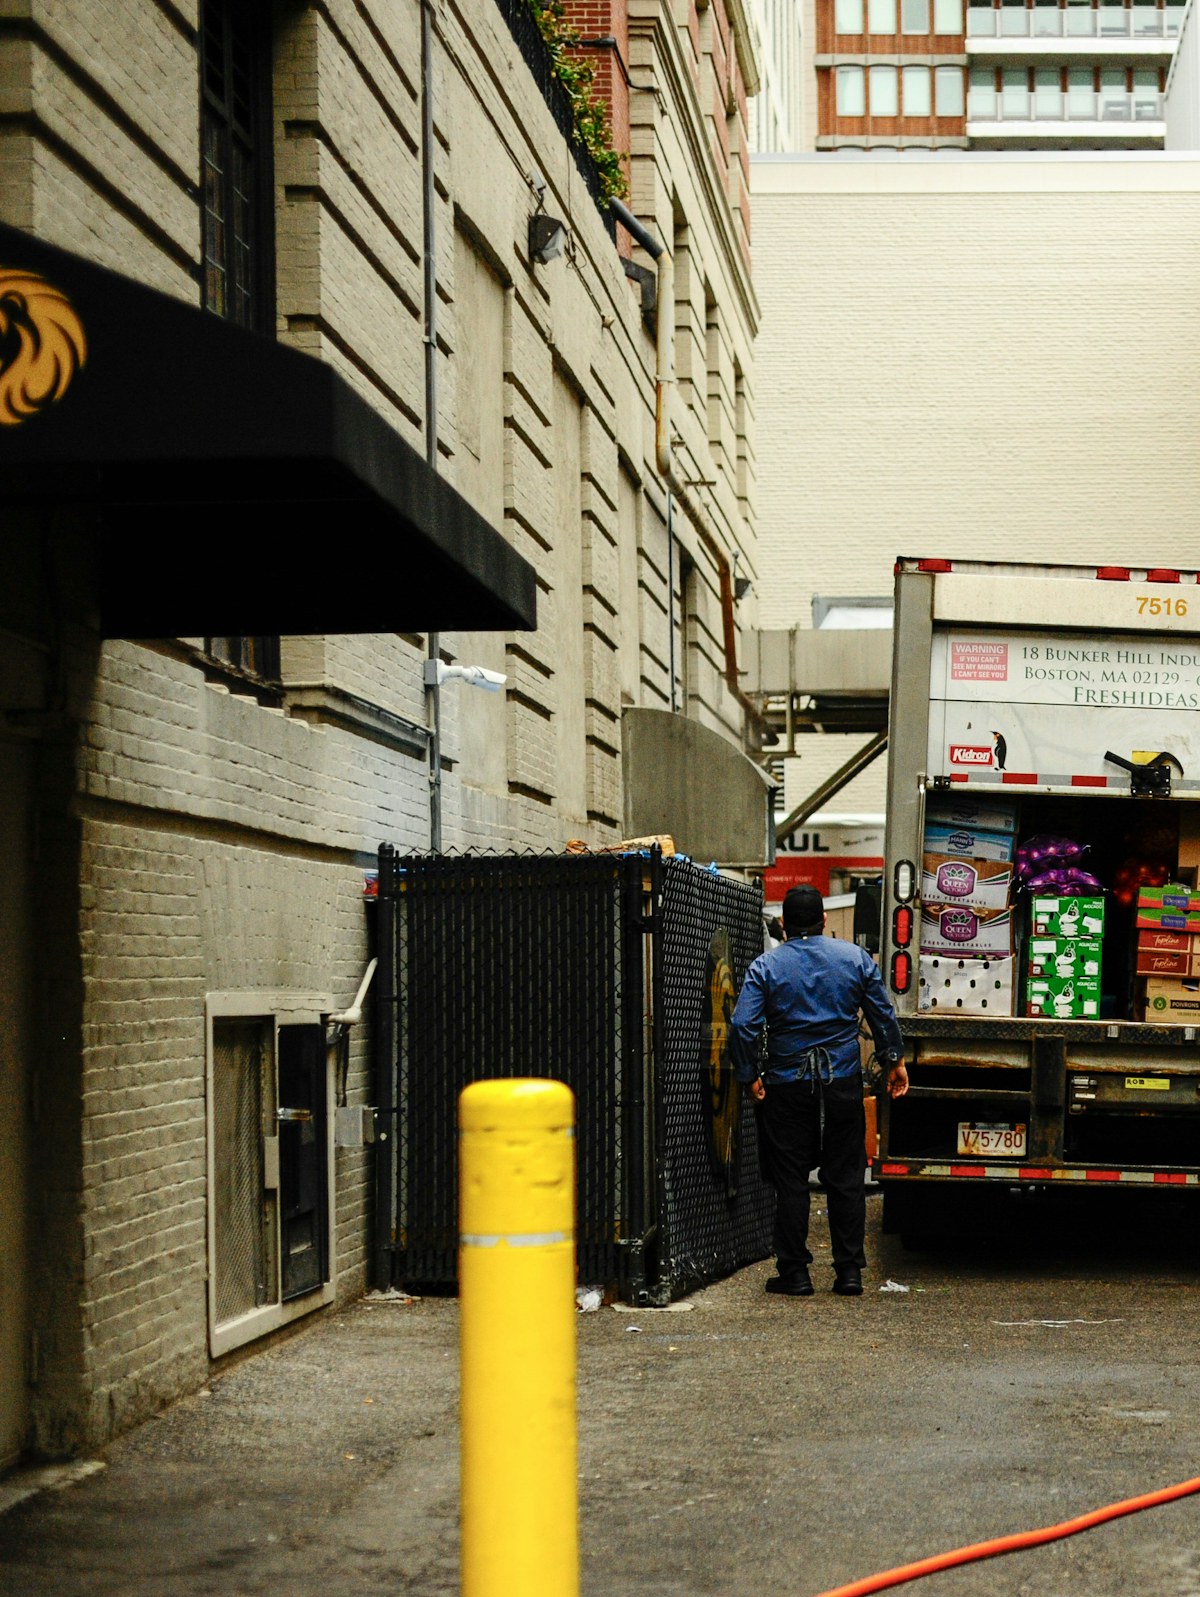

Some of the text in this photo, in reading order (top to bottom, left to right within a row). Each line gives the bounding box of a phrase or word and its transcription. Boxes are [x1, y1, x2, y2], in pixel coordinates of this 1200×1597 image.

[1136, 597, 1188, 616] 7516
[955, 644, 1004, 654] WARNING
[1022, 646, 1039, 660] 18
[1046, 648, 1111, 663] BUNKER
[1117, 651, 1154, 666] HILL
[1025, 666, 1094, 682] BOSTON,
[1101, 670, 1127, 684] MA
[1133, 671, 1180, 685] 02129
[953, 749, 990, 762] Kidron
[942, 879, 969, 888] QUEEN
[946, 925, 972, 934] QUEEN
[1152, 934, 1180, 947] Topline
[1151, 958, 1178, 970] Topline
